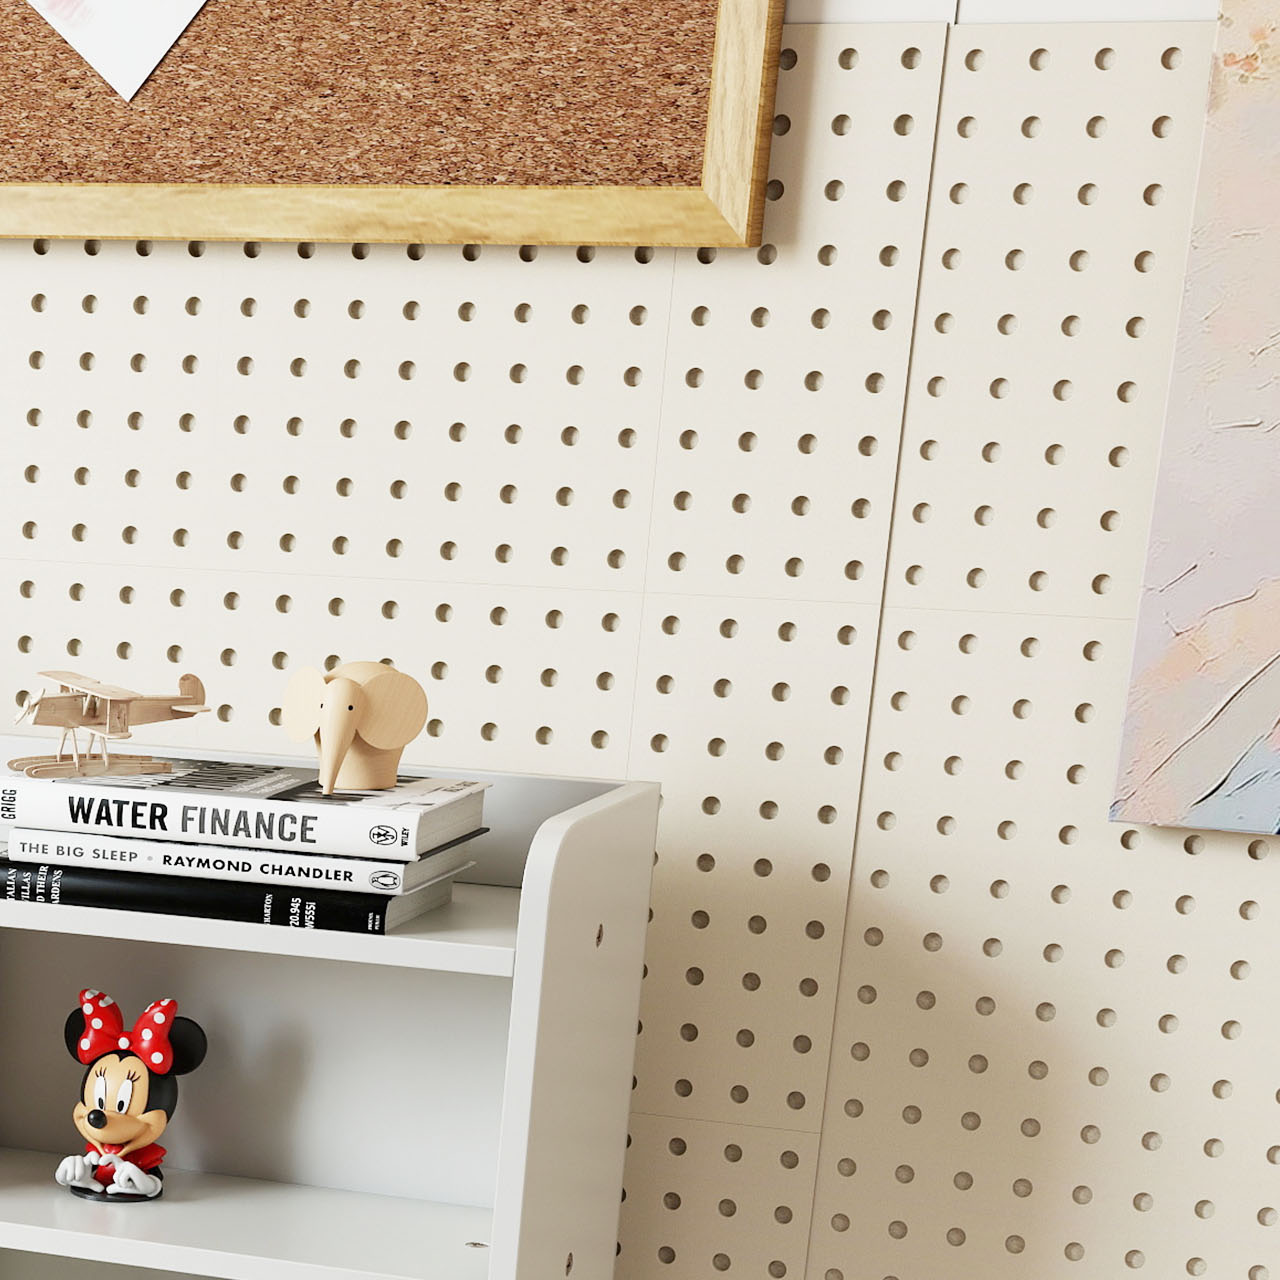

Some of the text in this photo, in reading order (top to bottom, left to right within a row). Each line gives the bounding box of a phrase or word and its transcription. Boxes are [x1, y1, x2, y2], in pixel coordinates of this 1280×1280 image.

[0, 788, 17, 820] GRIGG
[67, 795, 319, 844] WATER FINANCE
[400, 826, 410, 847] WILEY
[19, 841, 354, 882] THE BIG SLEEP RAYMOND CHANDLER
[6, 867, 17, 901] TALIAN
[21, 871, 32, 901] ILLAS
[36, 865, 49, 894] THEIR
[289, 897, 302, 927] 20.945
